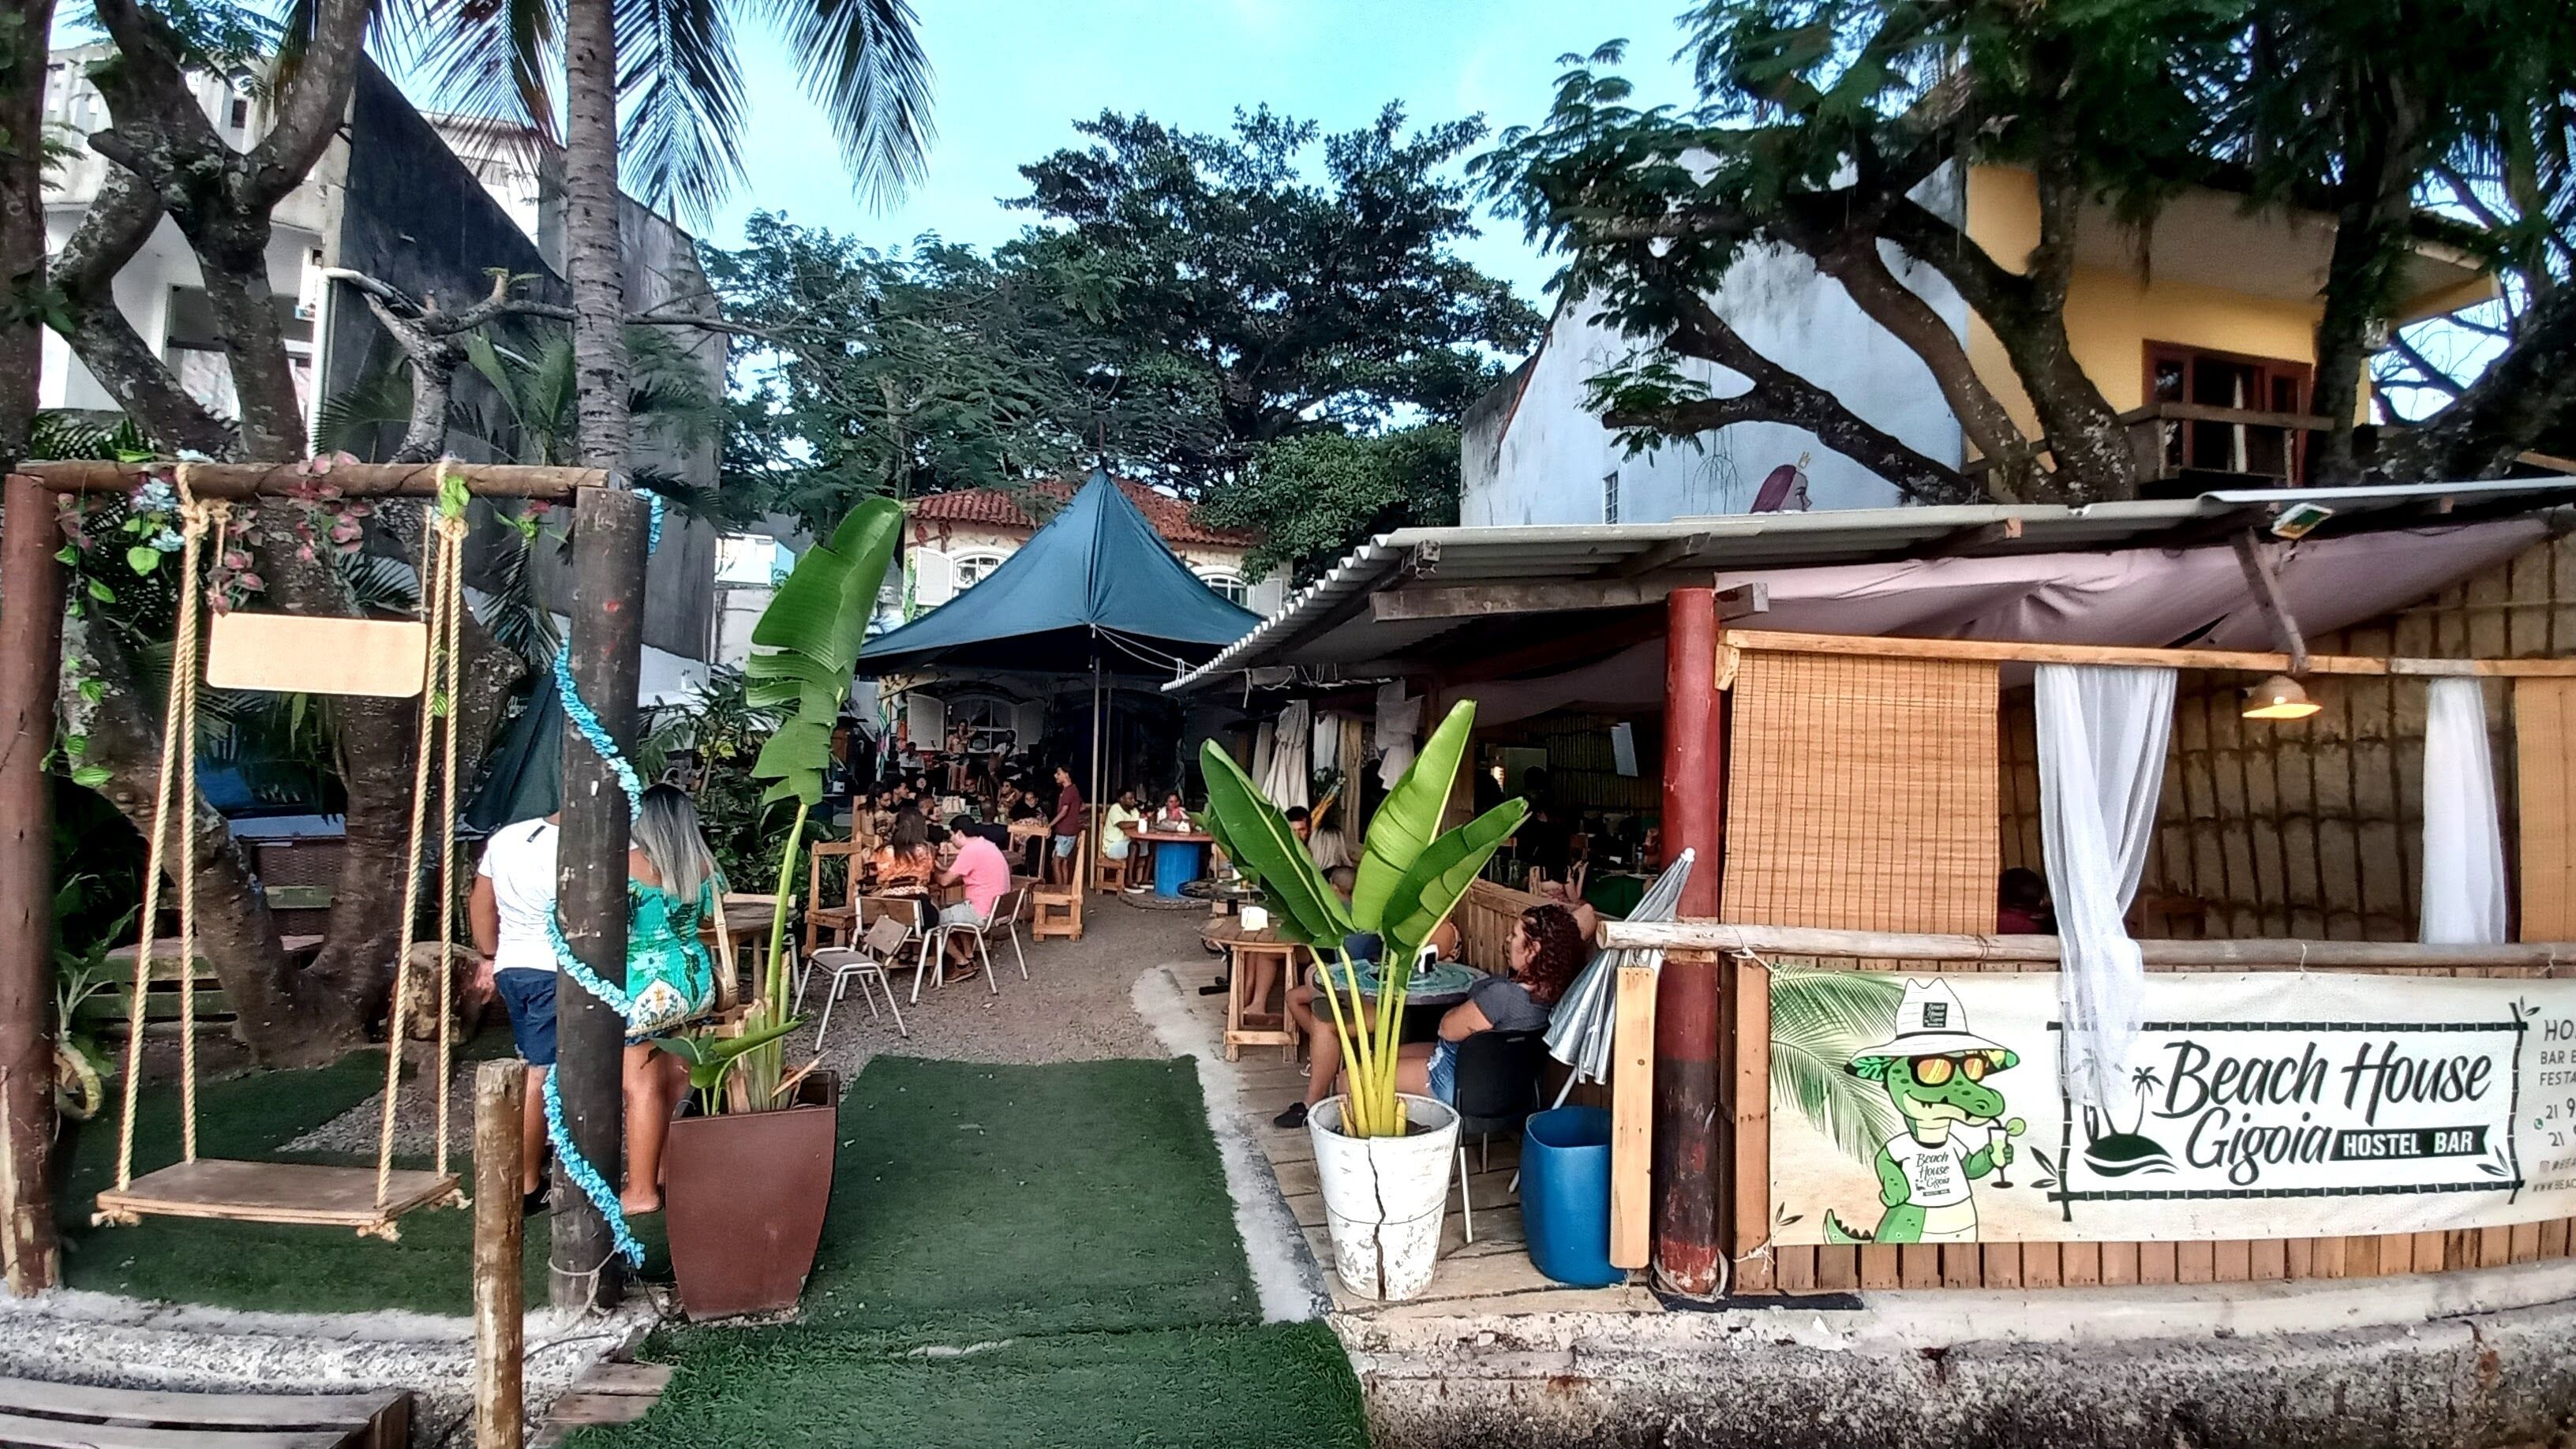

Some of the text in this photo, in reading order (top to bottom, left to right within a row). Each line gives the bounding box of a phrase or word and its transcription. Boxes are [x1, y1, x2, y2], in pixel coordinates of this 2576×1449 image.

[2544, 1019, 2576, 1041] HO
[2540, 1050, 2565, 1065] BAR
[2151, 1039, 2492, 1127] Beach House
[2545, 1097, 2575, 1119] 21 9
[2185, 1106, 2473, 1186] Gigoia HOSTEL BAR
[2548, 1131, 2564, 1147] 21
[1915, 1151, 1949, 1167] Beach
[1919, 1166, 1949, 1181] House
